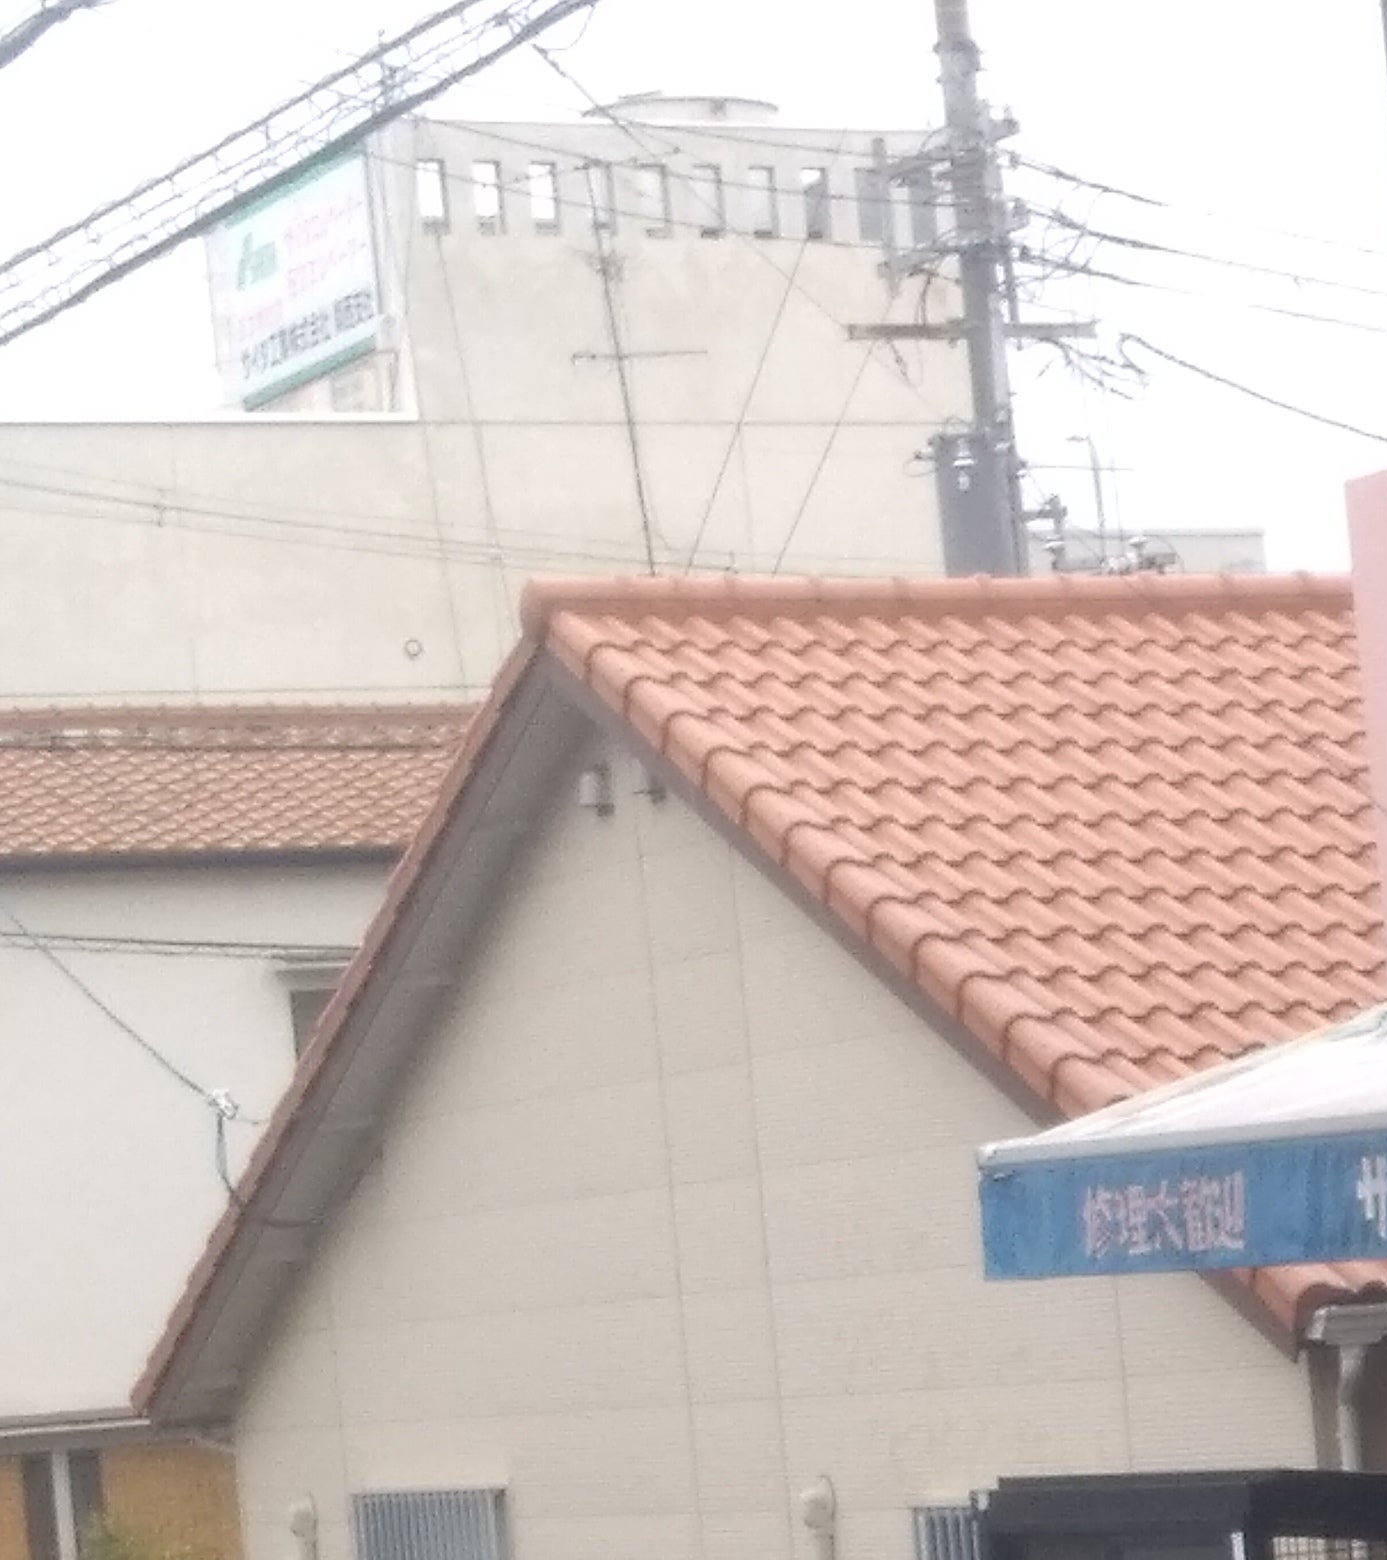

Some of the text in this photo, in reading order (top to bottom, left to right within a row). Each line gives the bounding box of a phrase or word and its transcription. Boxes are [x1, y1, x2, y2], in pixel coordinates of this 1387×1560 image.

[1083, 1170, 1246, 1258] 修理大歓迎
